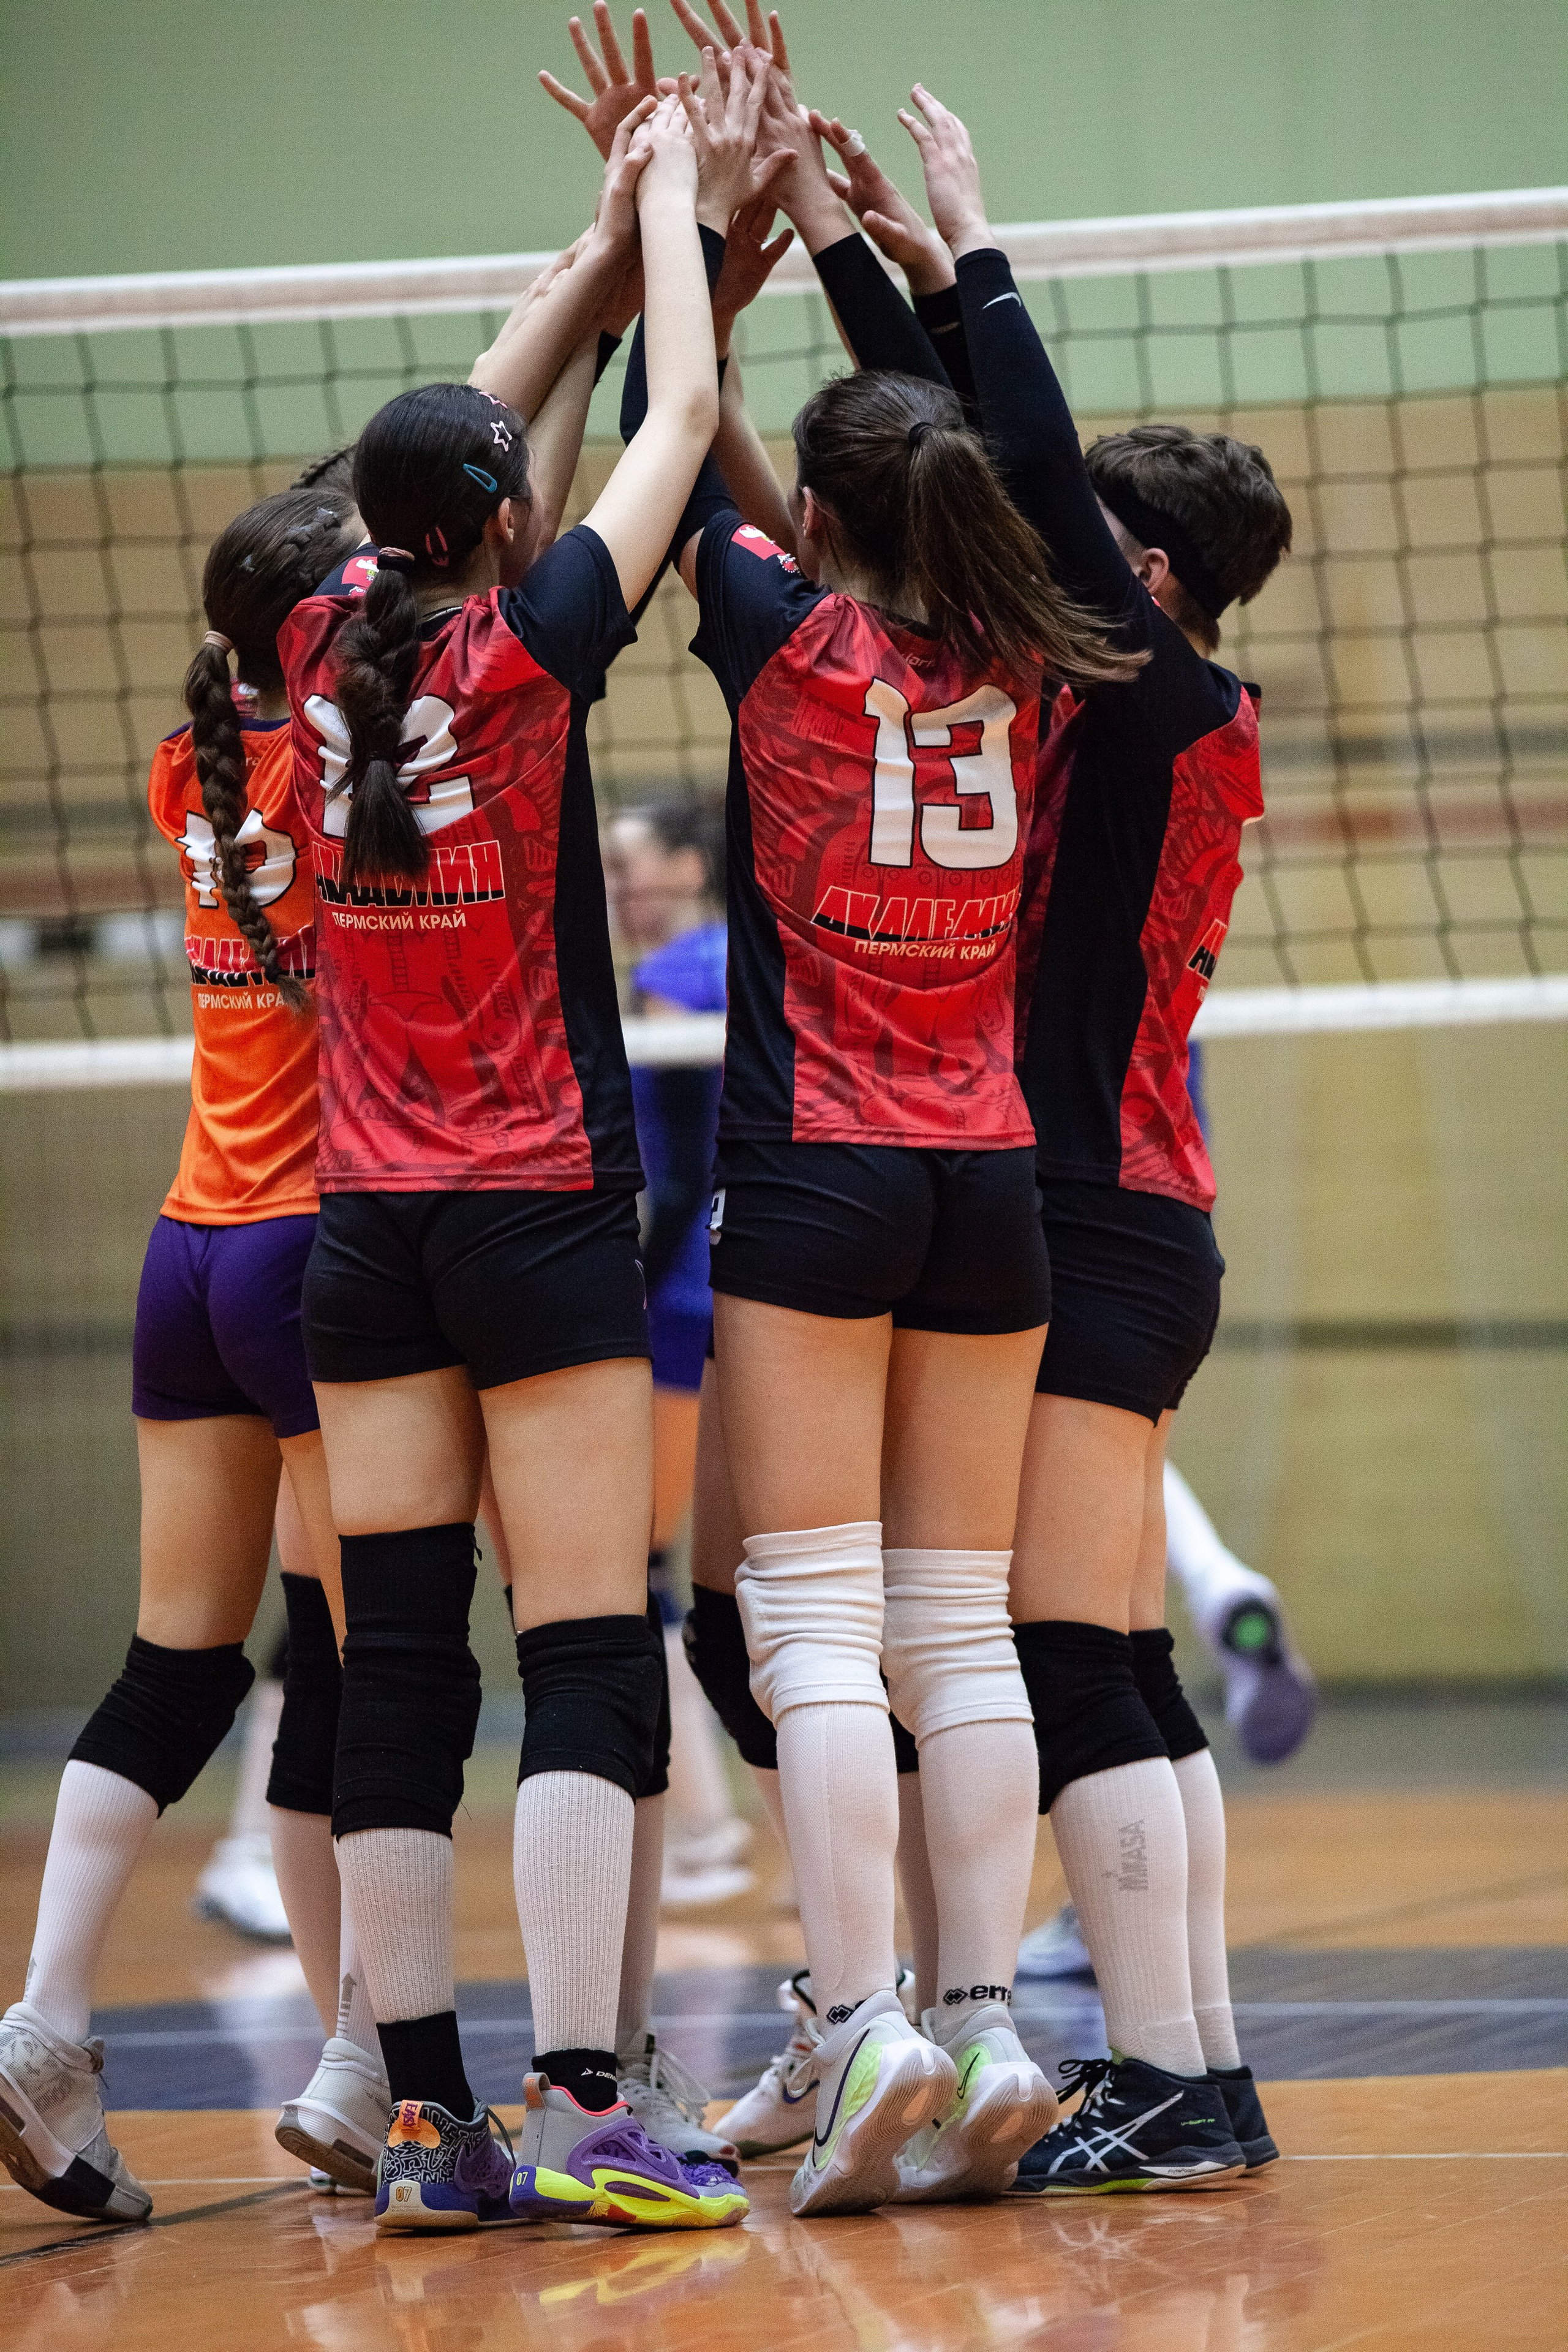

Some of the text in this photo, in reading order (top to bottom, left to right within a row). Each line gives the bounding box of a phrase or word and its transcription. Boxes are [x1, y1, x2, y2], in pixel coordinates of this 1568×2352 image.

[862, 676, 1019, 870] 13
[331, 909, 466, 930] ПЕРМСКИЙ КРАЙ
[854, 939, 996, 960] ПЕРМСКИЙ КРАЙ
[256, 992, 285, 1009] КРА
[596, 2071, 617, 2082] DEM
[516, 2172, 527, 2186] 07
[396, 2186, 412, 2202] 07
